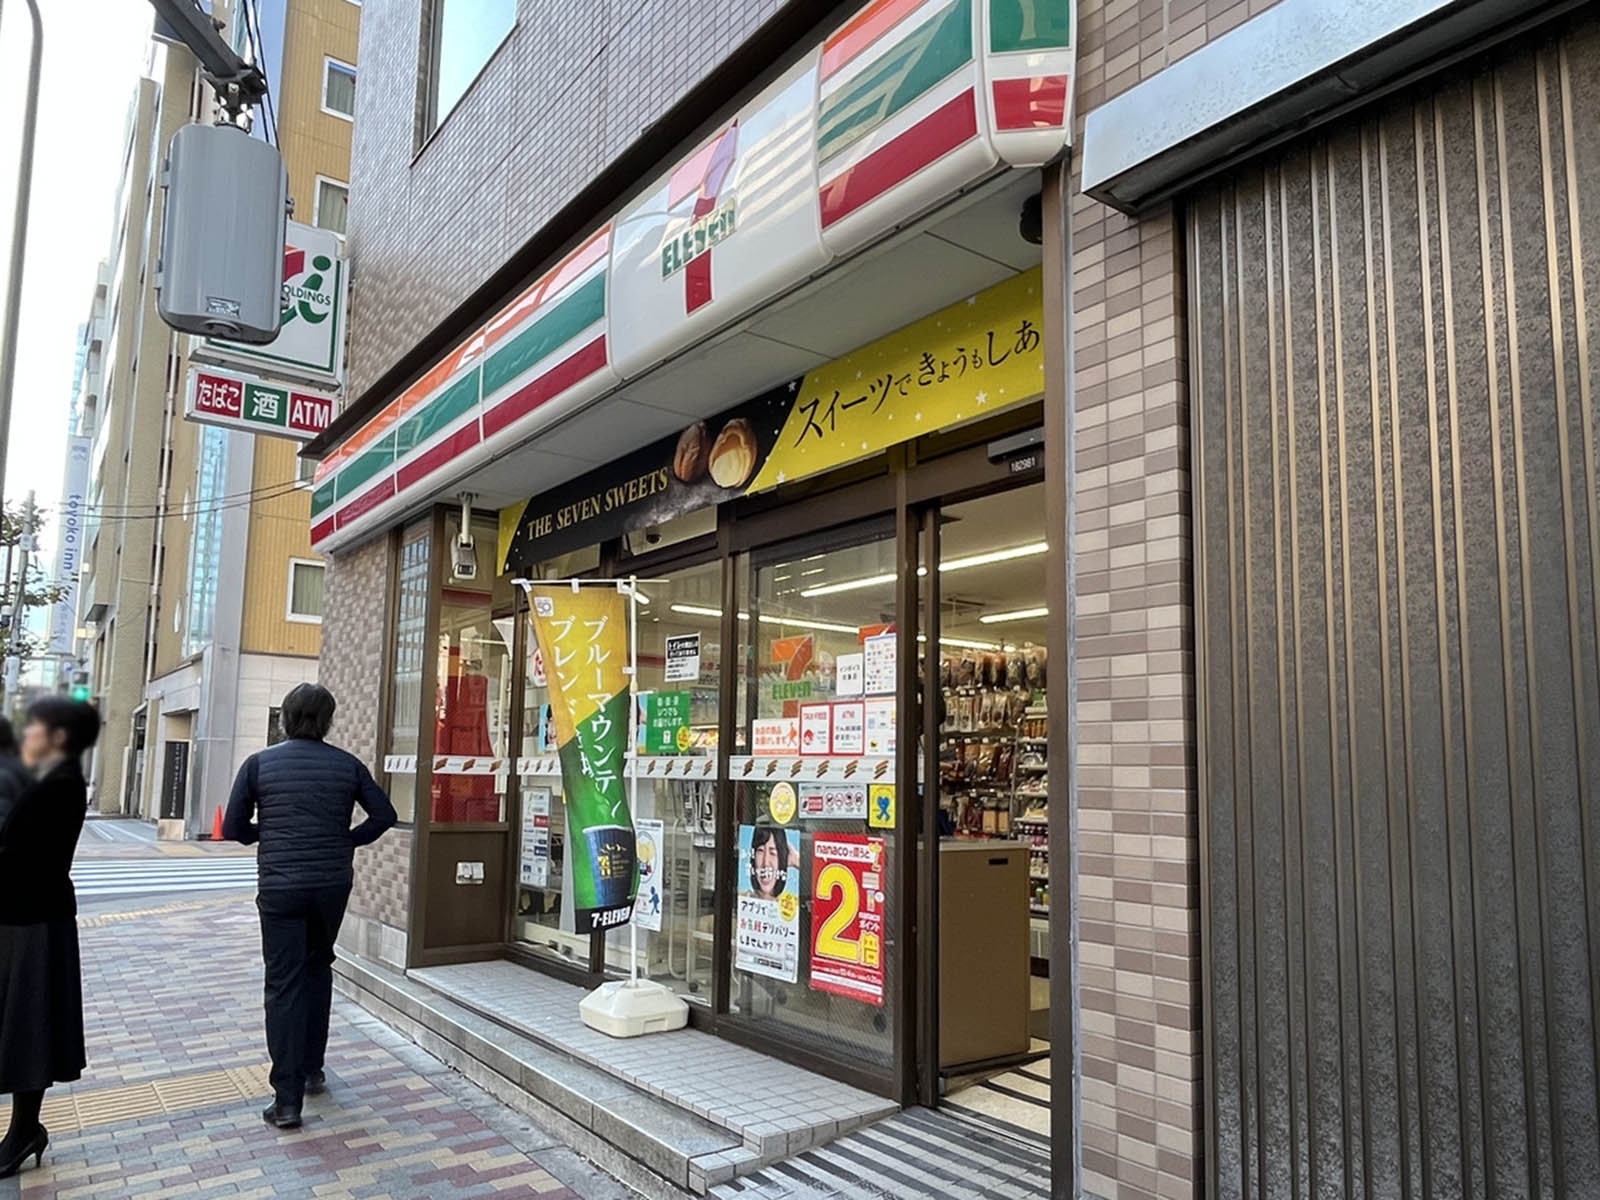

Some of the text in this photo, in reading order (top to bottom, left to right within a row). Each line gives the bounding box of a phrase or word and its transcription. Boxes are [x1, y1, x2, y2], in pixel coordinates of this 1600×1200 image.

[282, 285, 331, 306] OLDINGS
[197, 380, 240, 412] たばこ
[252, 390, 280, 419] 酒
[793, 320, 1040, 448] スイーツできょうもしあ
[291, 399, 330, 428] ATM
[527, 466, 669, 541] THE SEVEN SWEETS
[63, 494, 82, 571] toyoko inn
[815, 863, 860, 964] 2
